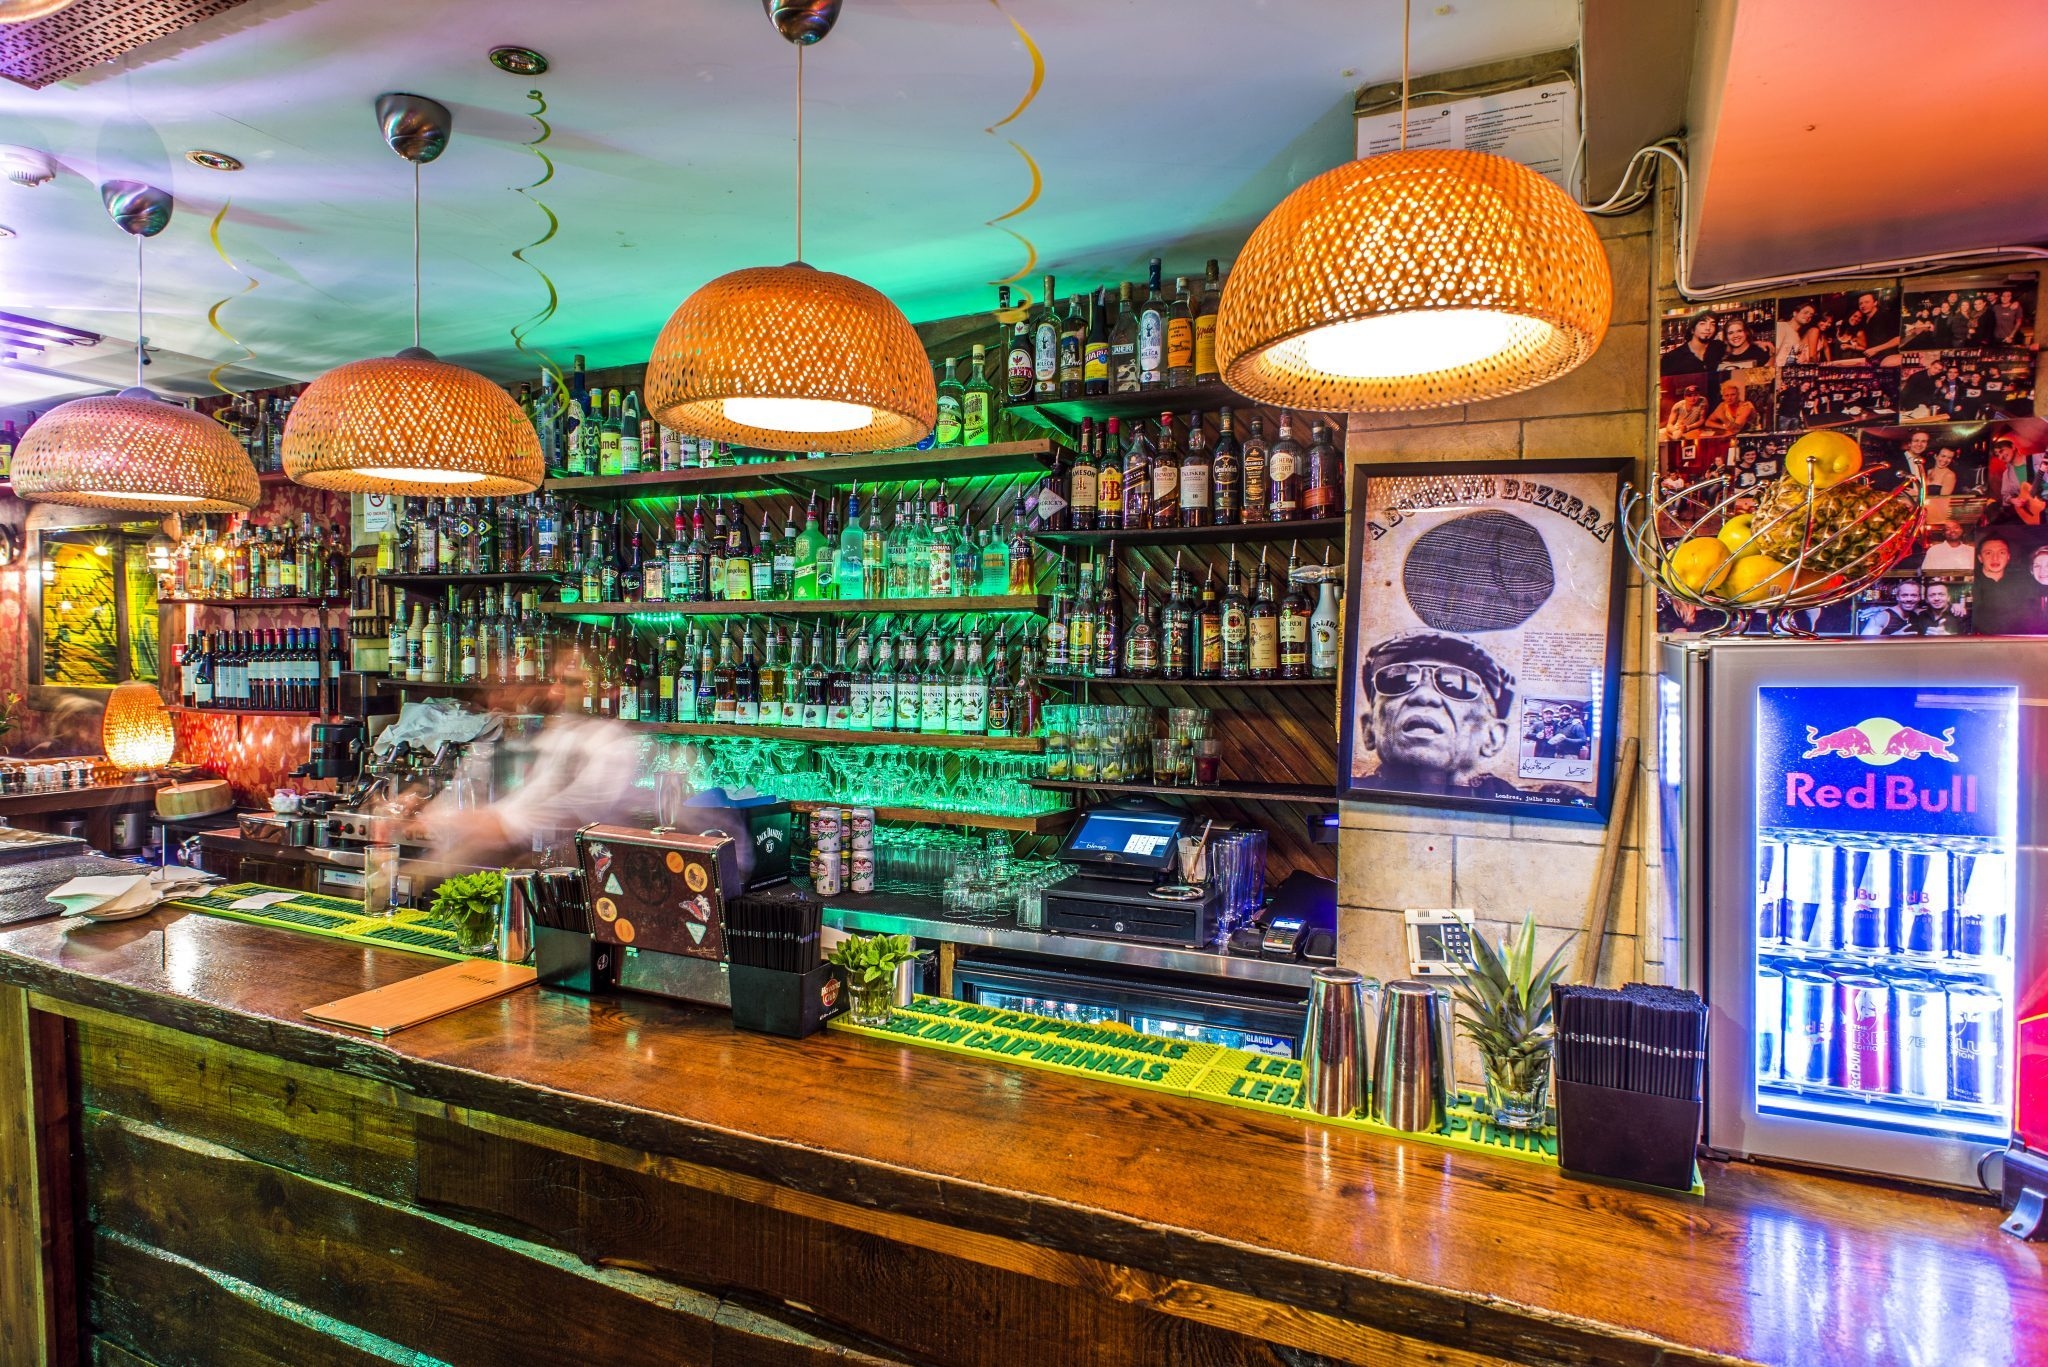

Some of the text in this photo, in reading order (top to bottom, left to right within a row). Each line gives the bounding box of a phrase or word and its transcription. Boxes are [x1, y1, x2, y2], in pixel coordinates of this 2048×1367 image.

[1366, 521, 1388, 541] A
[1500, 478, 1615, 544] BEZERRA
[1494, 792, 1523, 802] Londres,
[1785, 771, 1978, 814] Red Bull
[963, 1030, 1170, 1082] CAIPIRINHAS
[992, 1013, 1190, 1060] CAIPIRINHAS
[1246, 1034, 1274, 1046] GLACIAL
[1244, 1055, 1303, 1081] LEB
